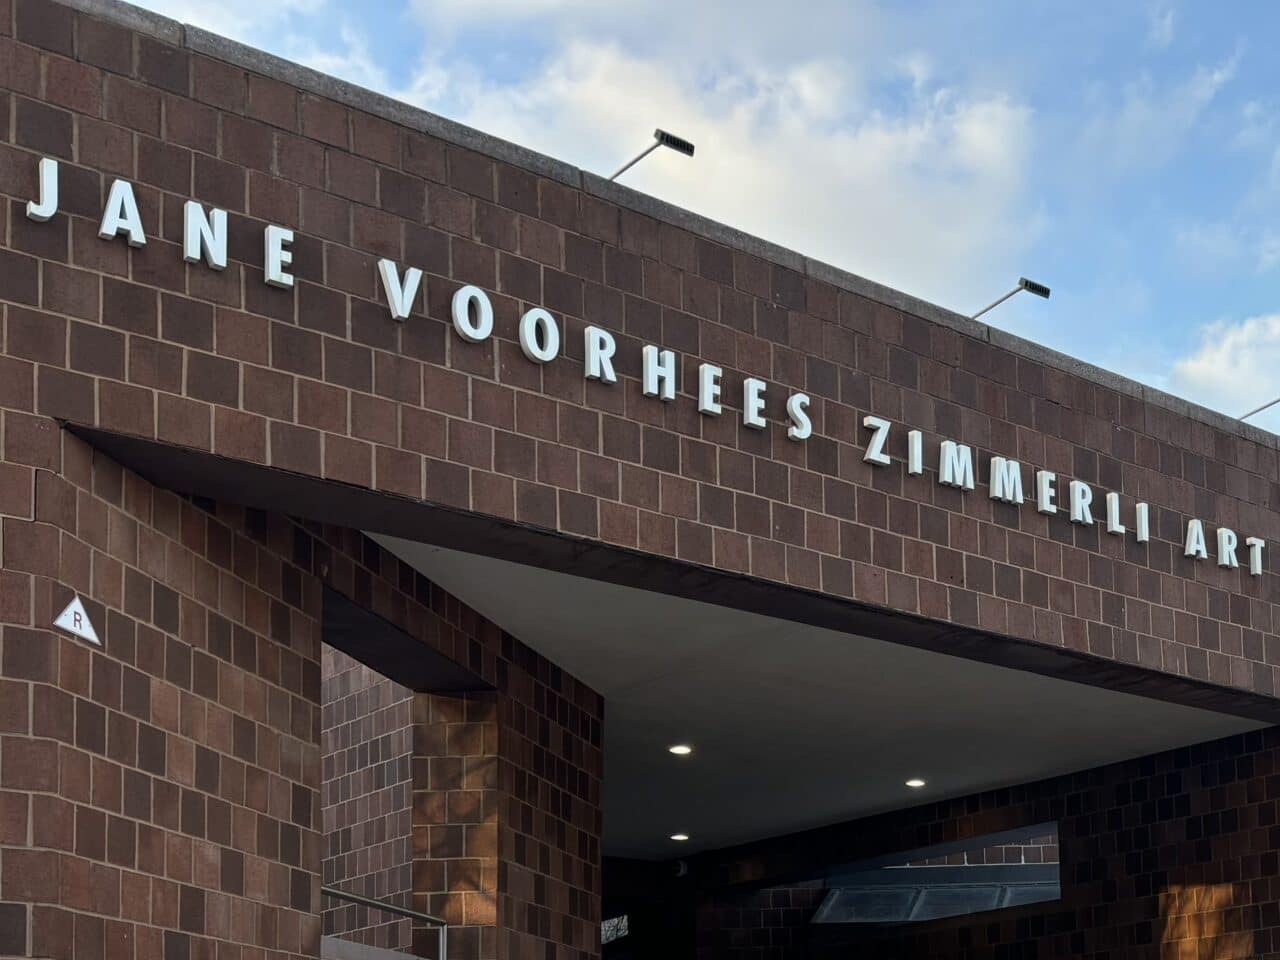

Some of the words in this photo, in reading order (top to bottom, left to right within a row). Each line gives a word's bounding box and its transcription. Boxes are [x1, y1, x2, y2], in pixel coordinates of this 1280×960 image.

[26, 156, 295, 289] JANE
[378, 257, 814, 442] VOORHEES
[863, 414, 1151, 543] ZIMMERLI
[1184, 518, 1267, 577] ART
[73, 610, 83, 630] R
